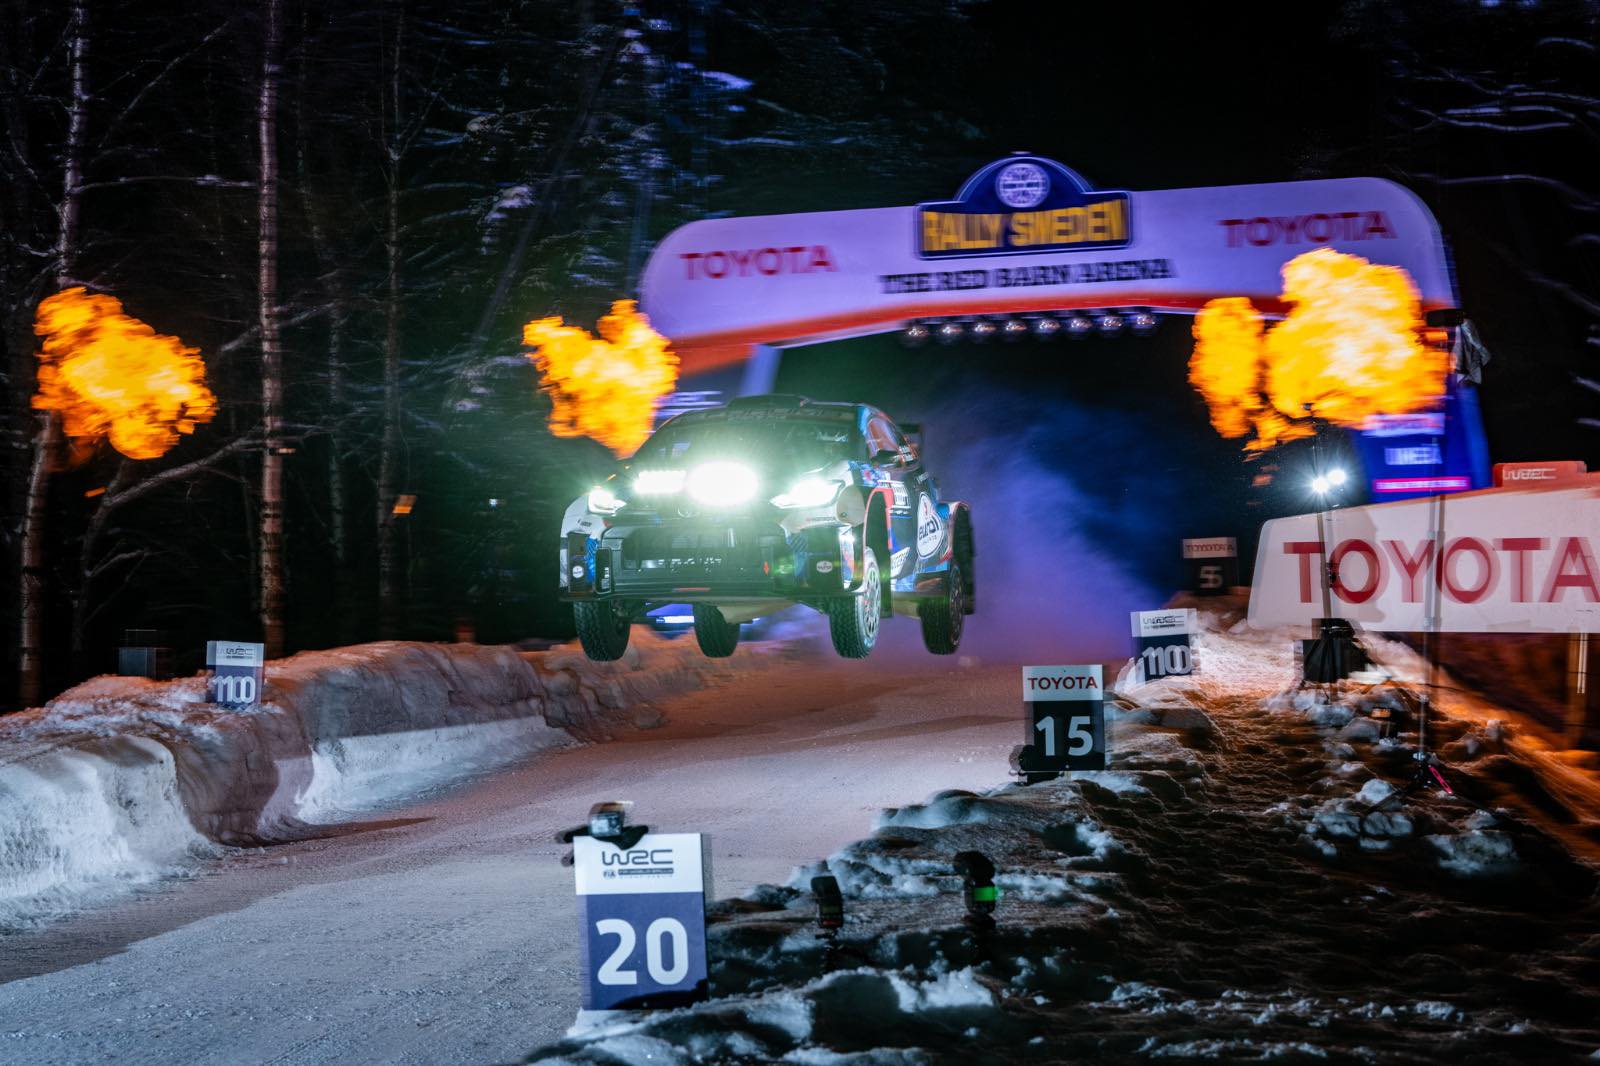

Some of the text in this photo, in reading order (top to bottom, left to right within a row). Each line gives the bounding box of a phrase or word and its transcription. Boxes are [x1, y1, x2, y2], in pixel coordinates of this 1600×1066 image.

[922, 199, 1129, 250] RALLY SWEDEN
[1217, 211, 1397, 248] TOYOTA
[680, 245, 838, 280] TOYOTA
[880, 258, 1177, 294] THE RED BARN ARENA
[1199, 565, 1224, 589] 5
[1283, 536, 1600, 604] TOYOTA
[1027, 676, 1098, 690] TOYOTA
[1035, 715, 1094, 757] 15
[601, 848, 674, 866] WRC
[595, 916, 689, 986] 20
